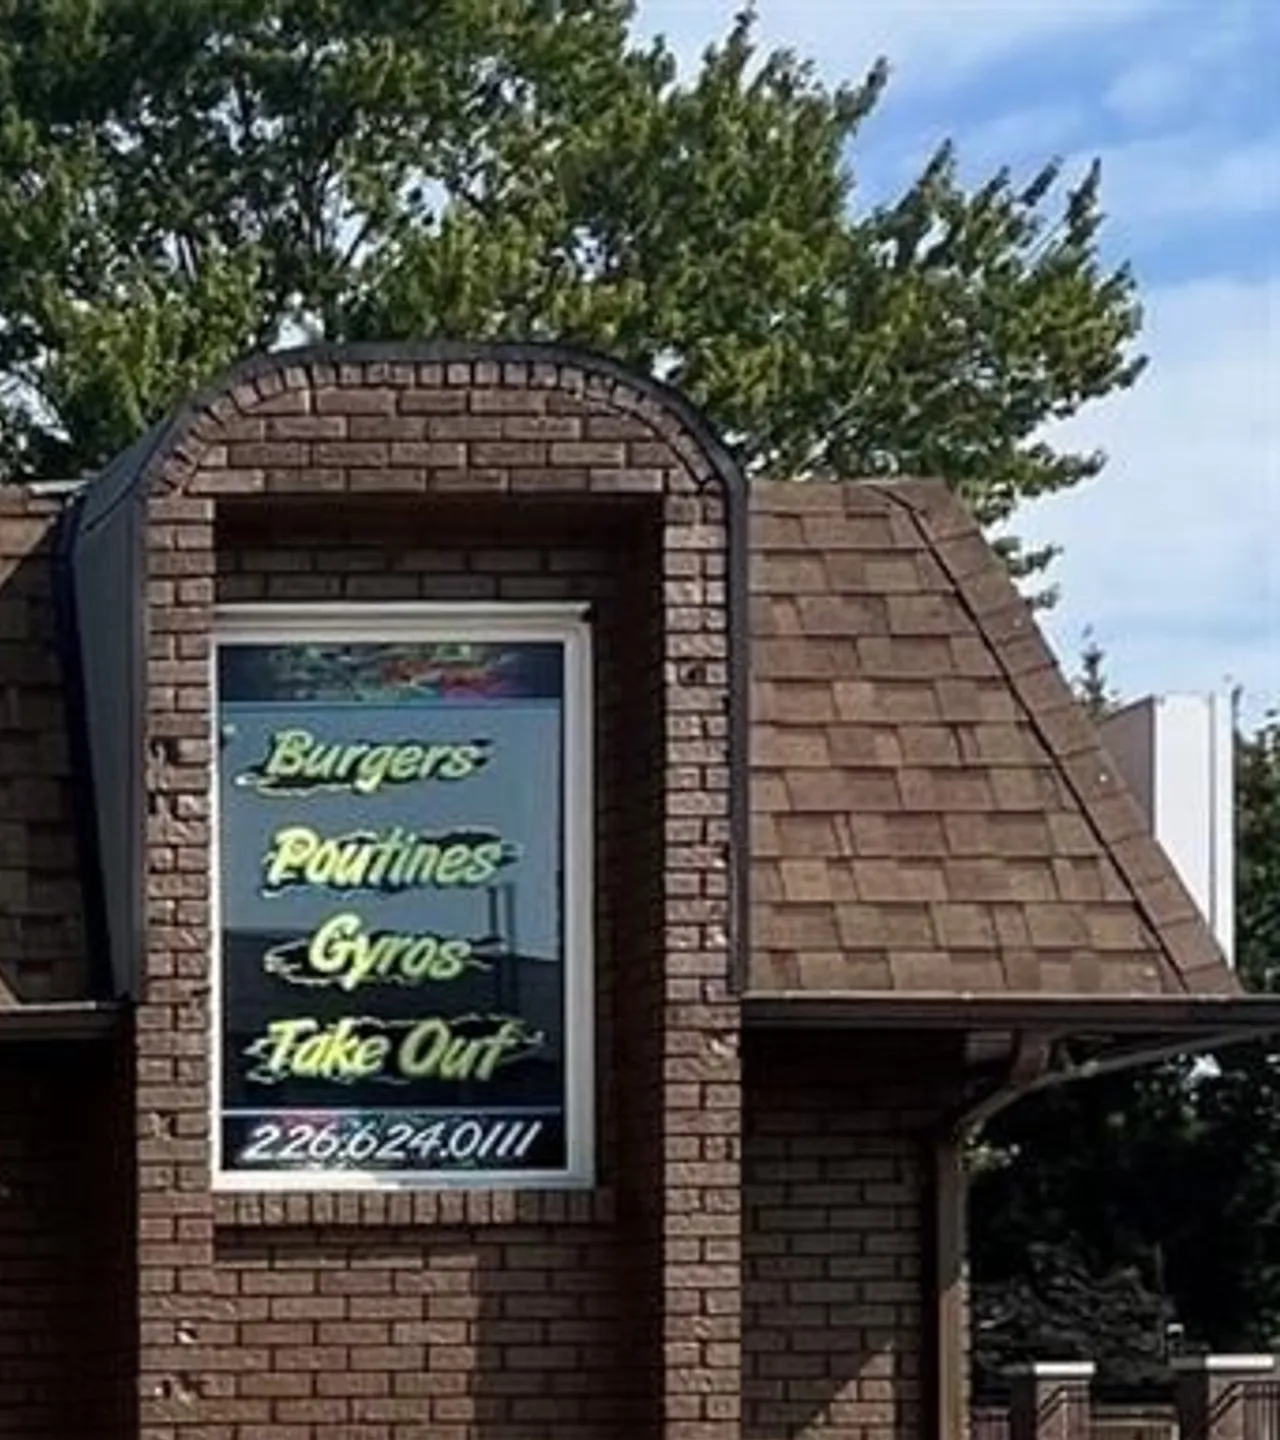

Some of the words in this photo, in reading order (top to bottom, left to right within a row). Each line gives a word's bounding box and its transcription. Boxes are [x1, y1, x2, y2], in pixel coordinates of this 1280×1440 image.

[267, 730, 480, 793] Burgers
[266, 826, 503, 888] Poutines
[307, 914, 474, 990] Gyros
[266, 1019, 390, 1078] Take
[397, 1017, 517, 1082] Out
[242, 1122, 544, 1162] 226.624.0111
